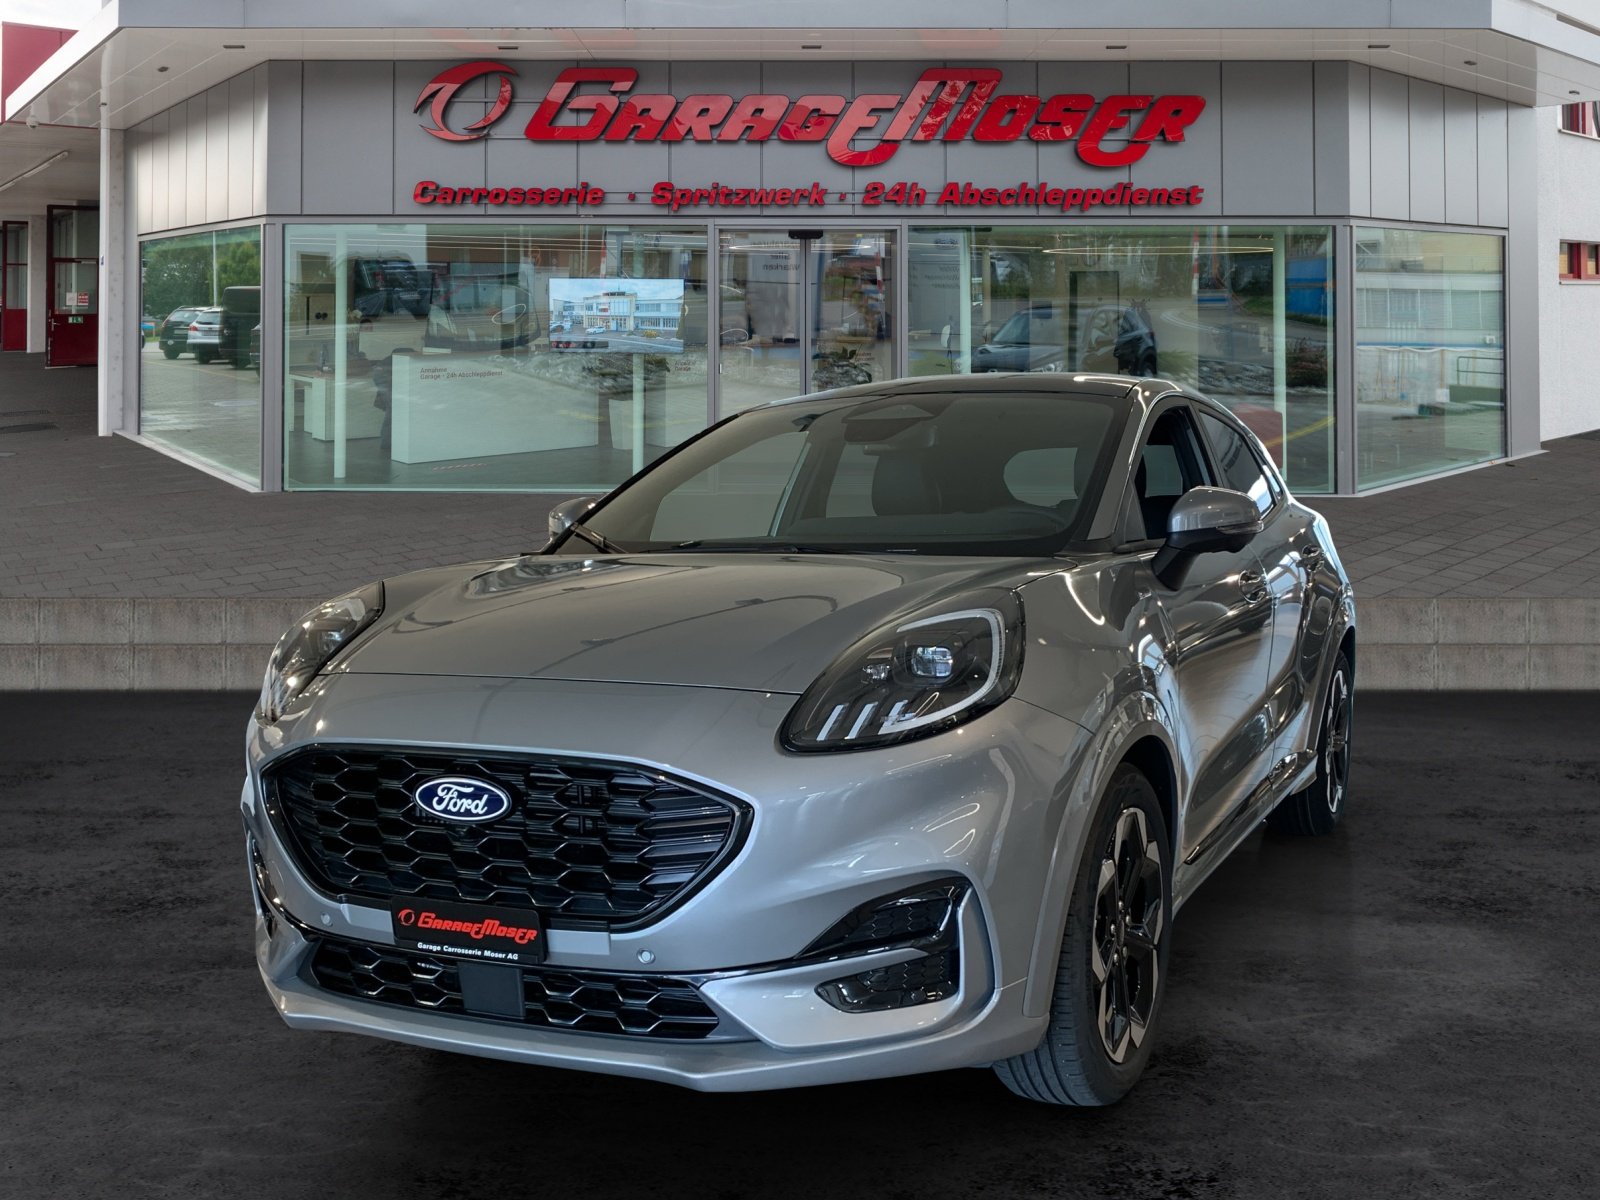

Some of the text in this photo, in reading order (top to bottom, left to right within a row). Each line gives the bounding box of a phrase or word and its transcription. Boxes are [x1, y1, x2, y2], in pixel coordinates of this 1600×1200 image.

[413, 181, 1204, 212] Carrosserie Spritzwerk 24h Abschleppdienst
[432, 783, 489, 815] Ford
[417, 942, 519, 960] Garage Carrosserie Moser AG
